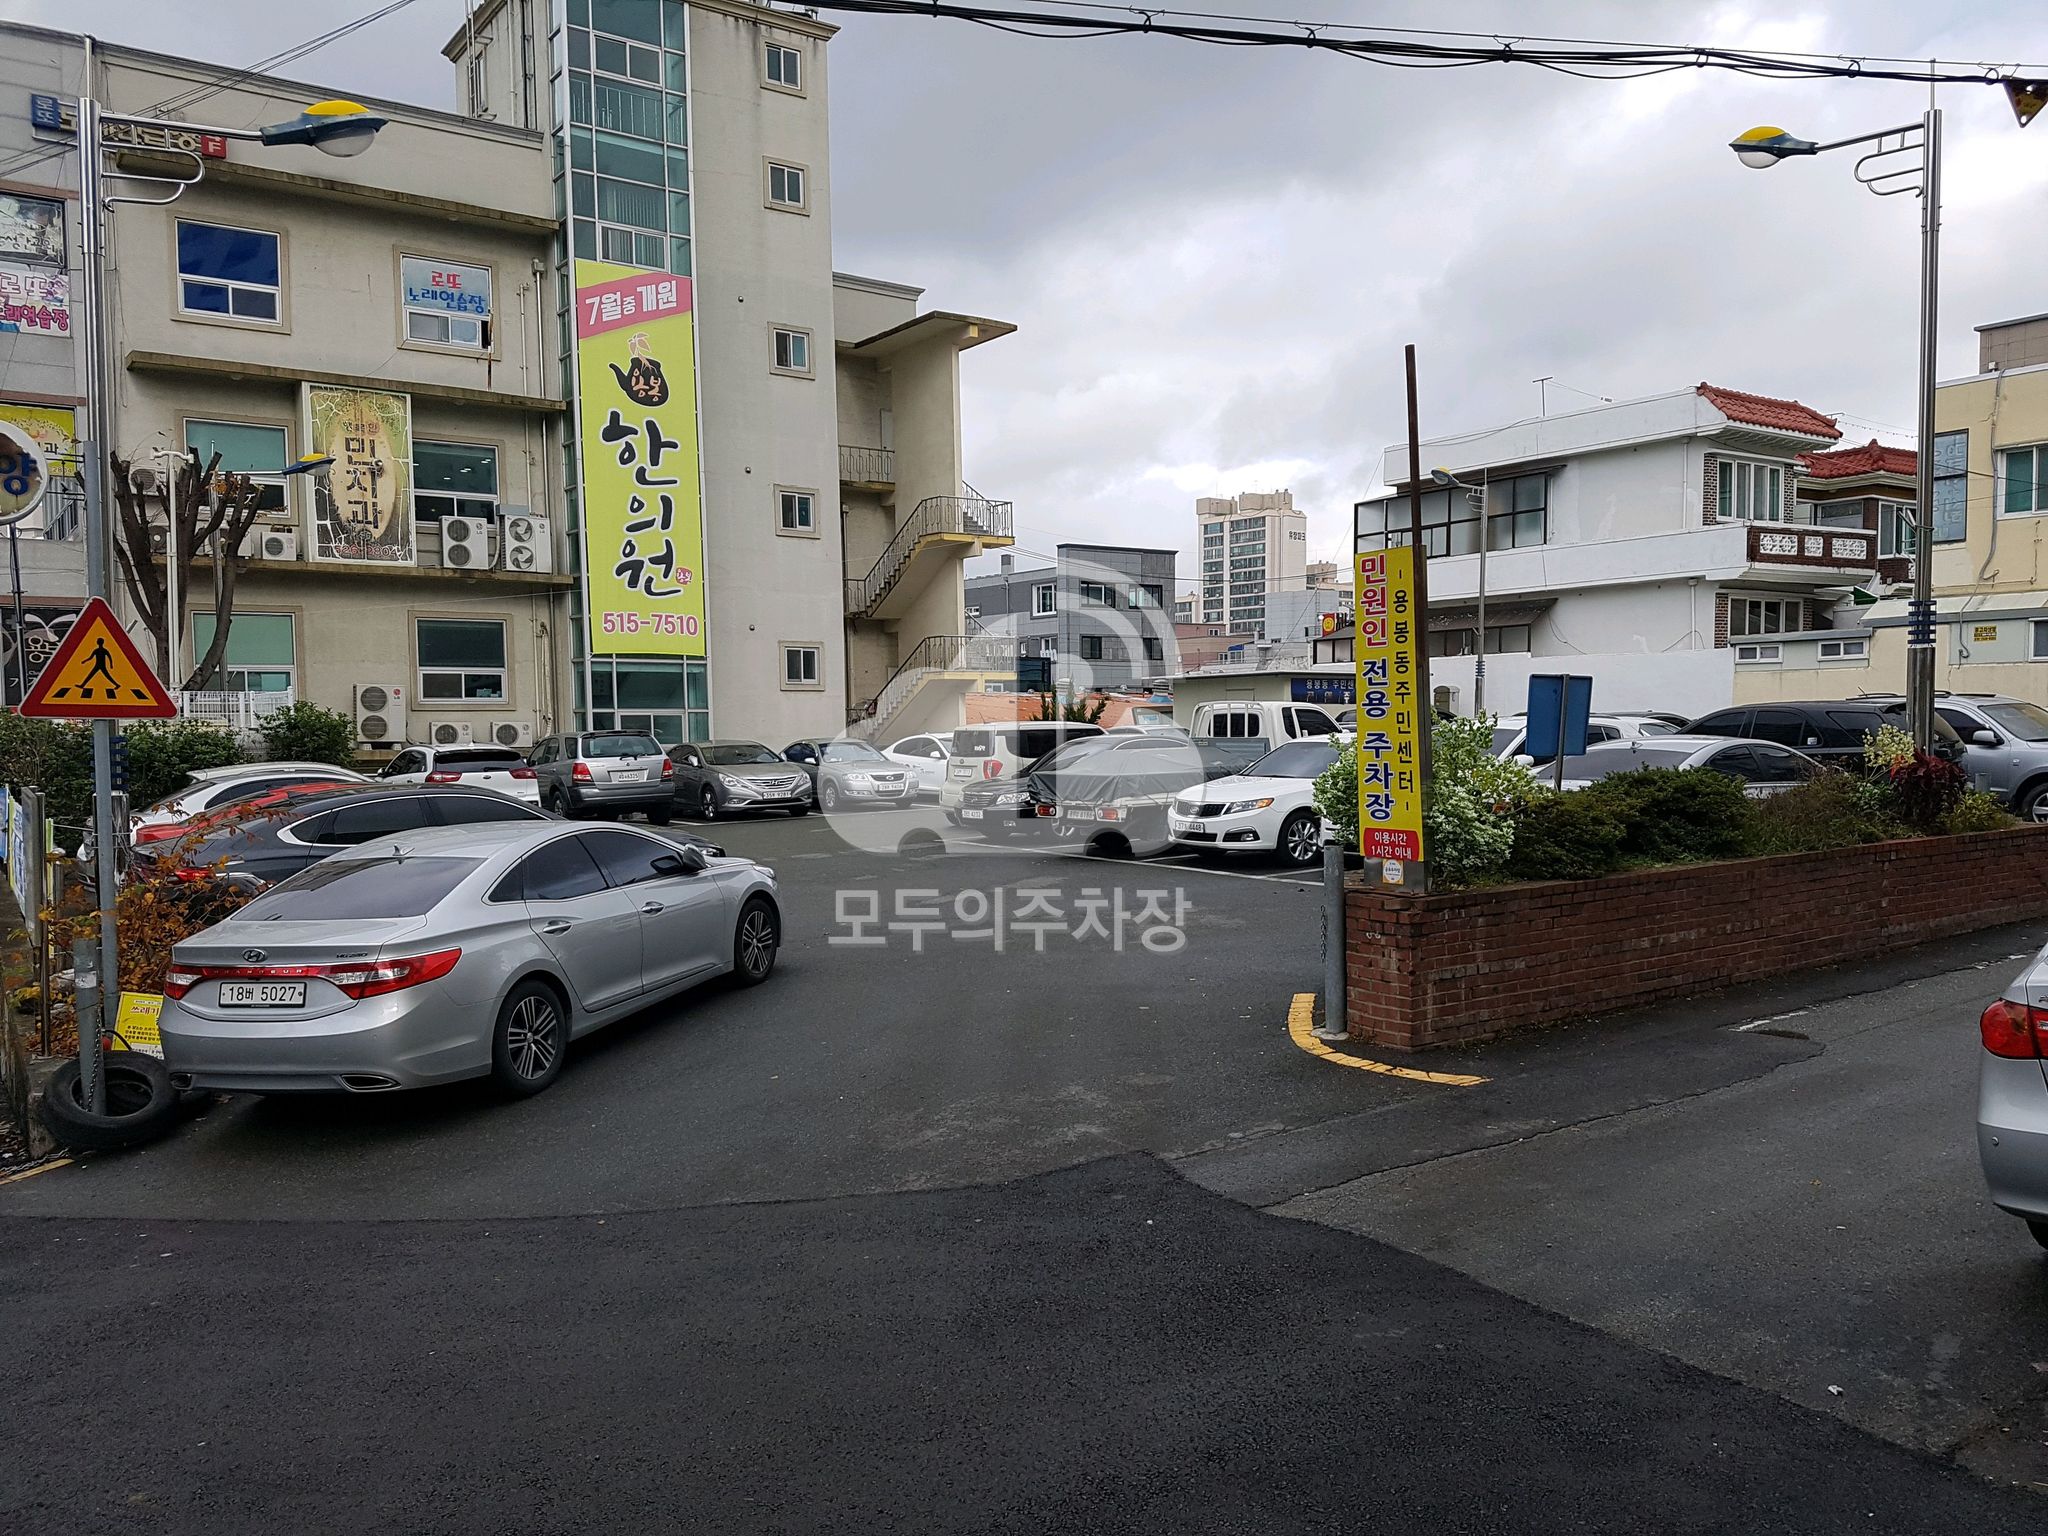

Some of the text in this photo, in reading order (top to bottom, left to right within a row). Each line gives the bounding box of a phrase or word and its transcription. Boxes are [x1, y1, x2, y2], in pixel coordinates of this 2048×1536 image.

[431, 270, 462, 289] 로또
[408, 287, 486, 314] 노래연습장
[637, 280, 677, 312] 개원
[601, 410, 682, 597] 한의원
[602, 612, 699, 636] 515-7510
[1360, 553, 1395, 821] 민원인 전용 주차장
[1374, 831, 1407, 846] 이용시간
[1371, 845, 1412, 860] 1시간 이내
[260, 986, 297, 1002] 5027
